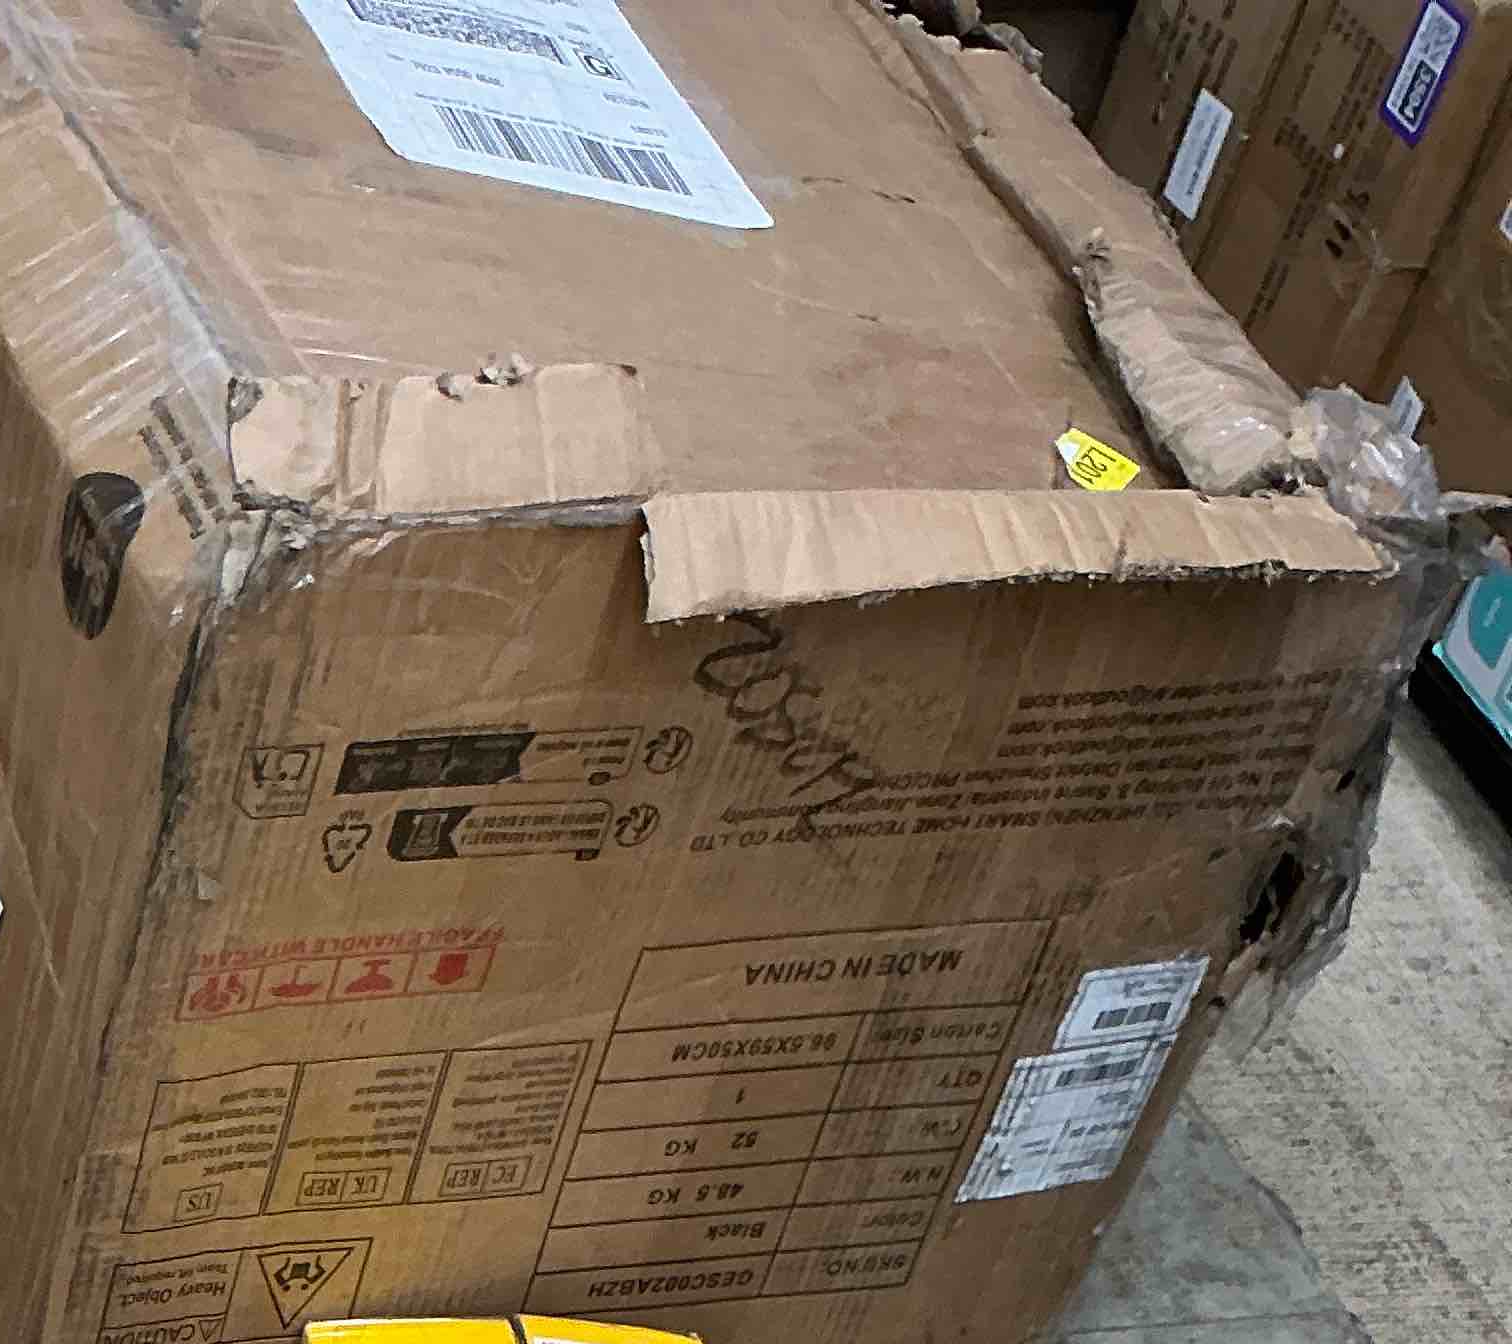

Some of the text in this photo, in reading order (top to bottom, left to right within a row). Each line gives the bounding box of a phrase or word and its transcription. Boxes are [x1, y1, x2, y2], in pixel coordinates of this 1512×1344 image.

[744, 948, 964, 986] MADE IN CHINA
[662, 1136, 698, 1157] KG
[302, 1176, 341, 1198] REP
[445, 1169, 481, 1192] REP
[647, 1186, 683, 1207] KG
[704, 1220, 766, 1241] Black
